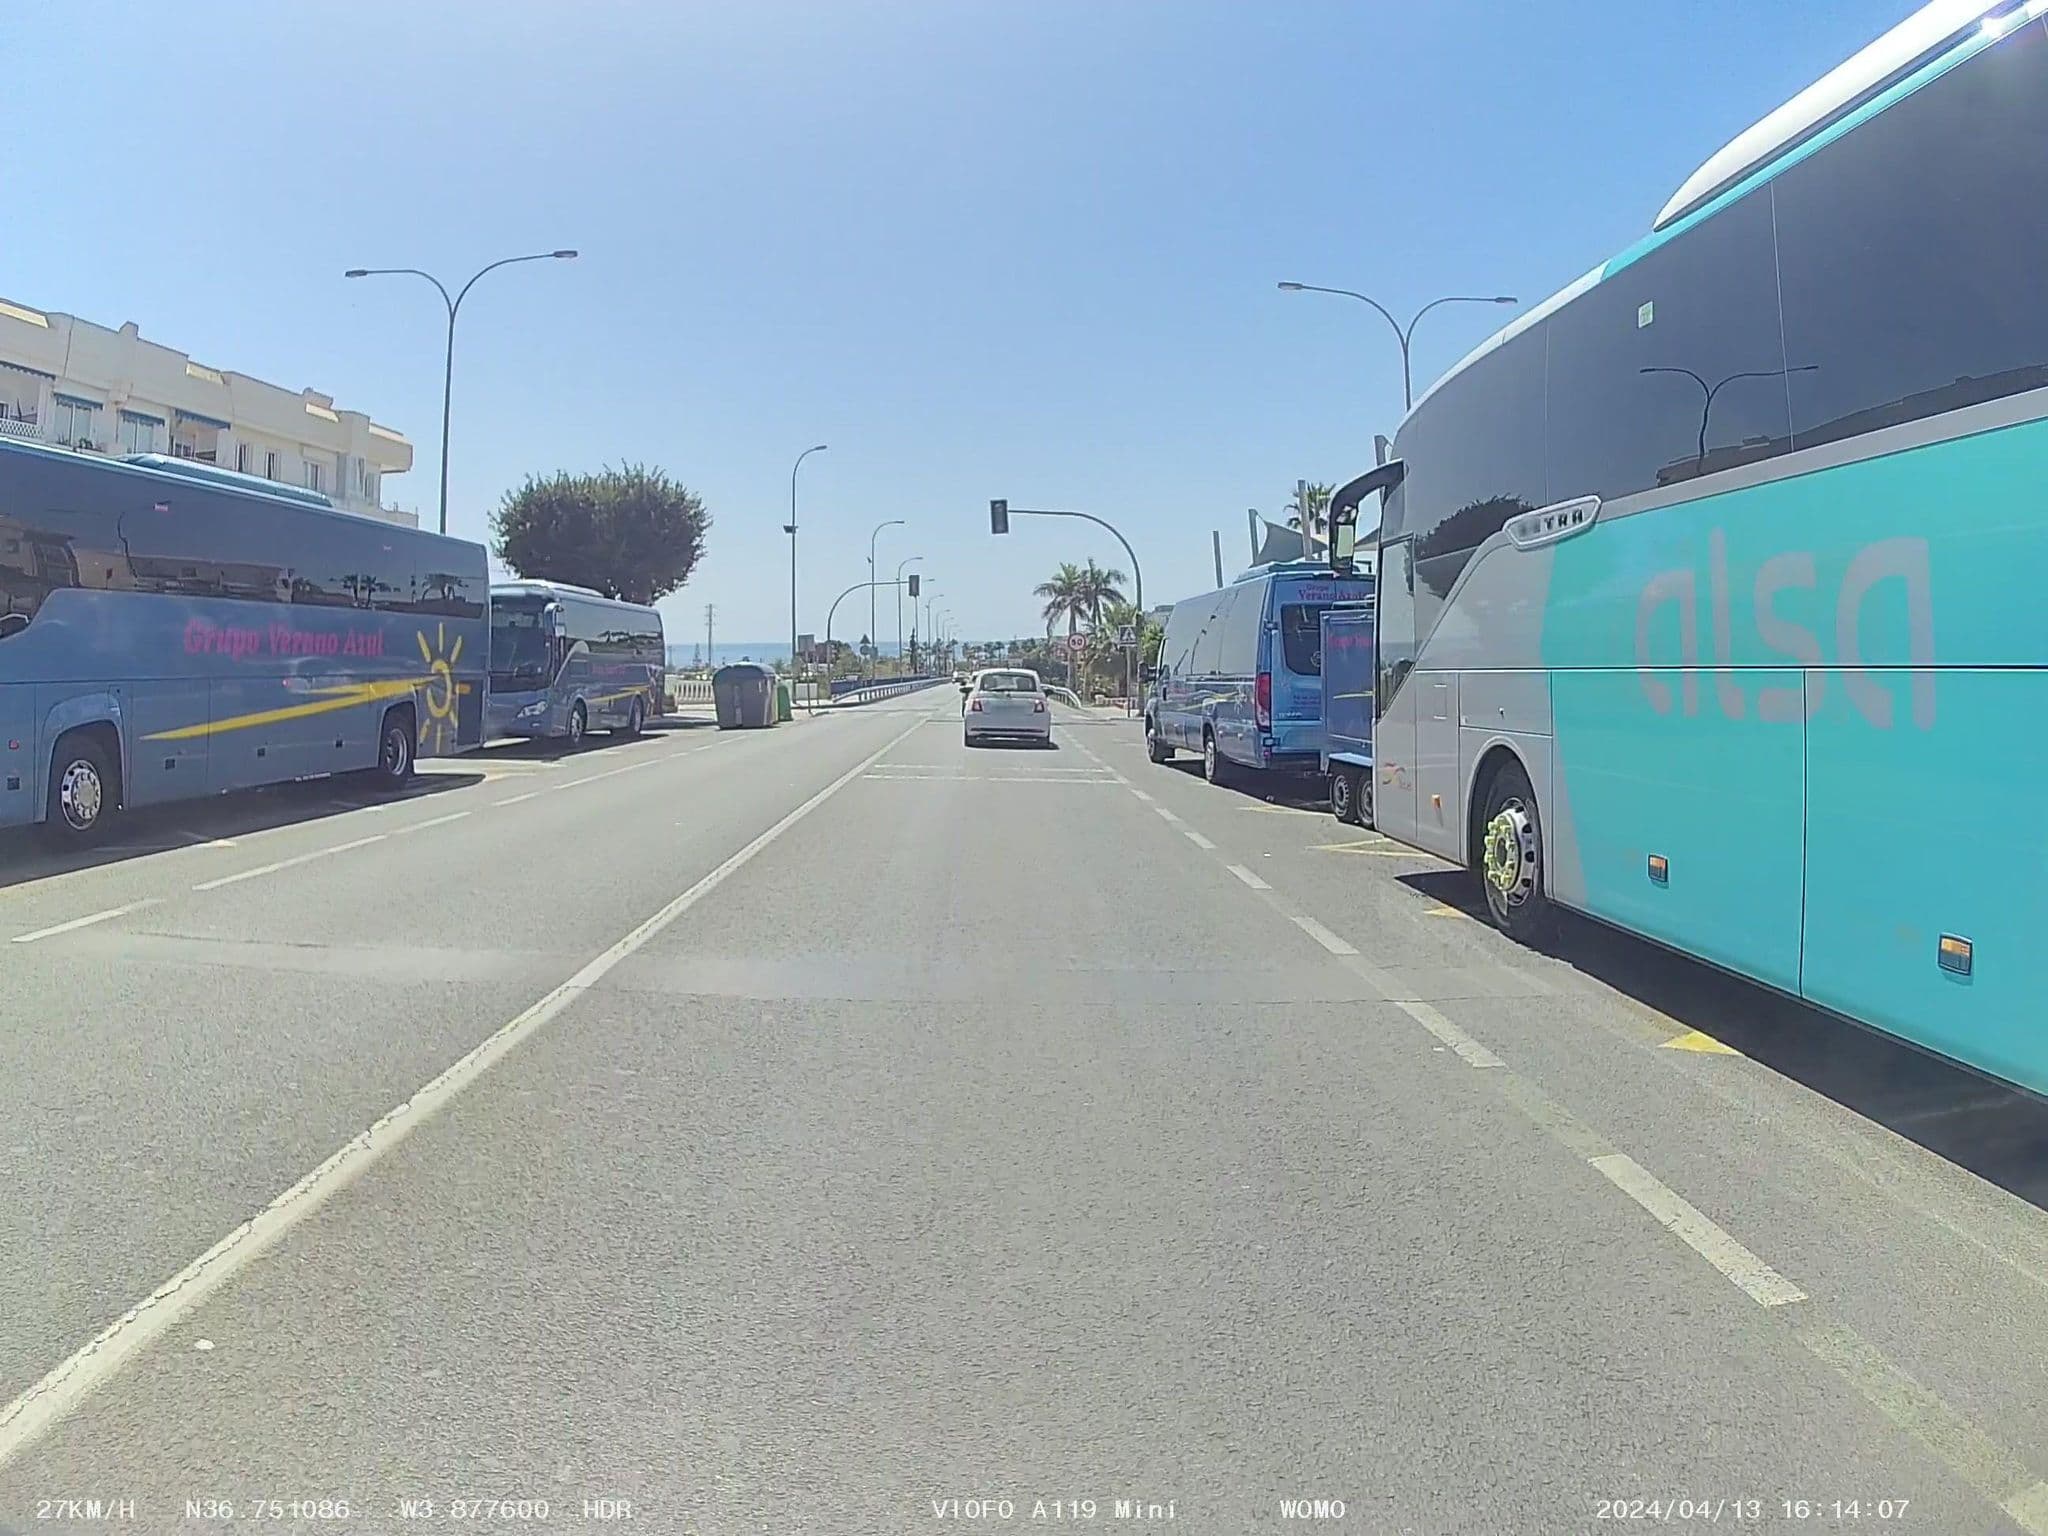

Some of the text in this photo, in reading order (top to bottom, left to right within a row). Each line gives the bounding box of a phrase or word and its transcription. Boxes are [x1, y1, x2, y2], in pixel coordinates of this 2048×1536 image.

[184, 619, 384, 662] Grupo Verano Azul
[1071, 638, 1083, 646] 50
[1635, 526, 1937, 733] alsa
